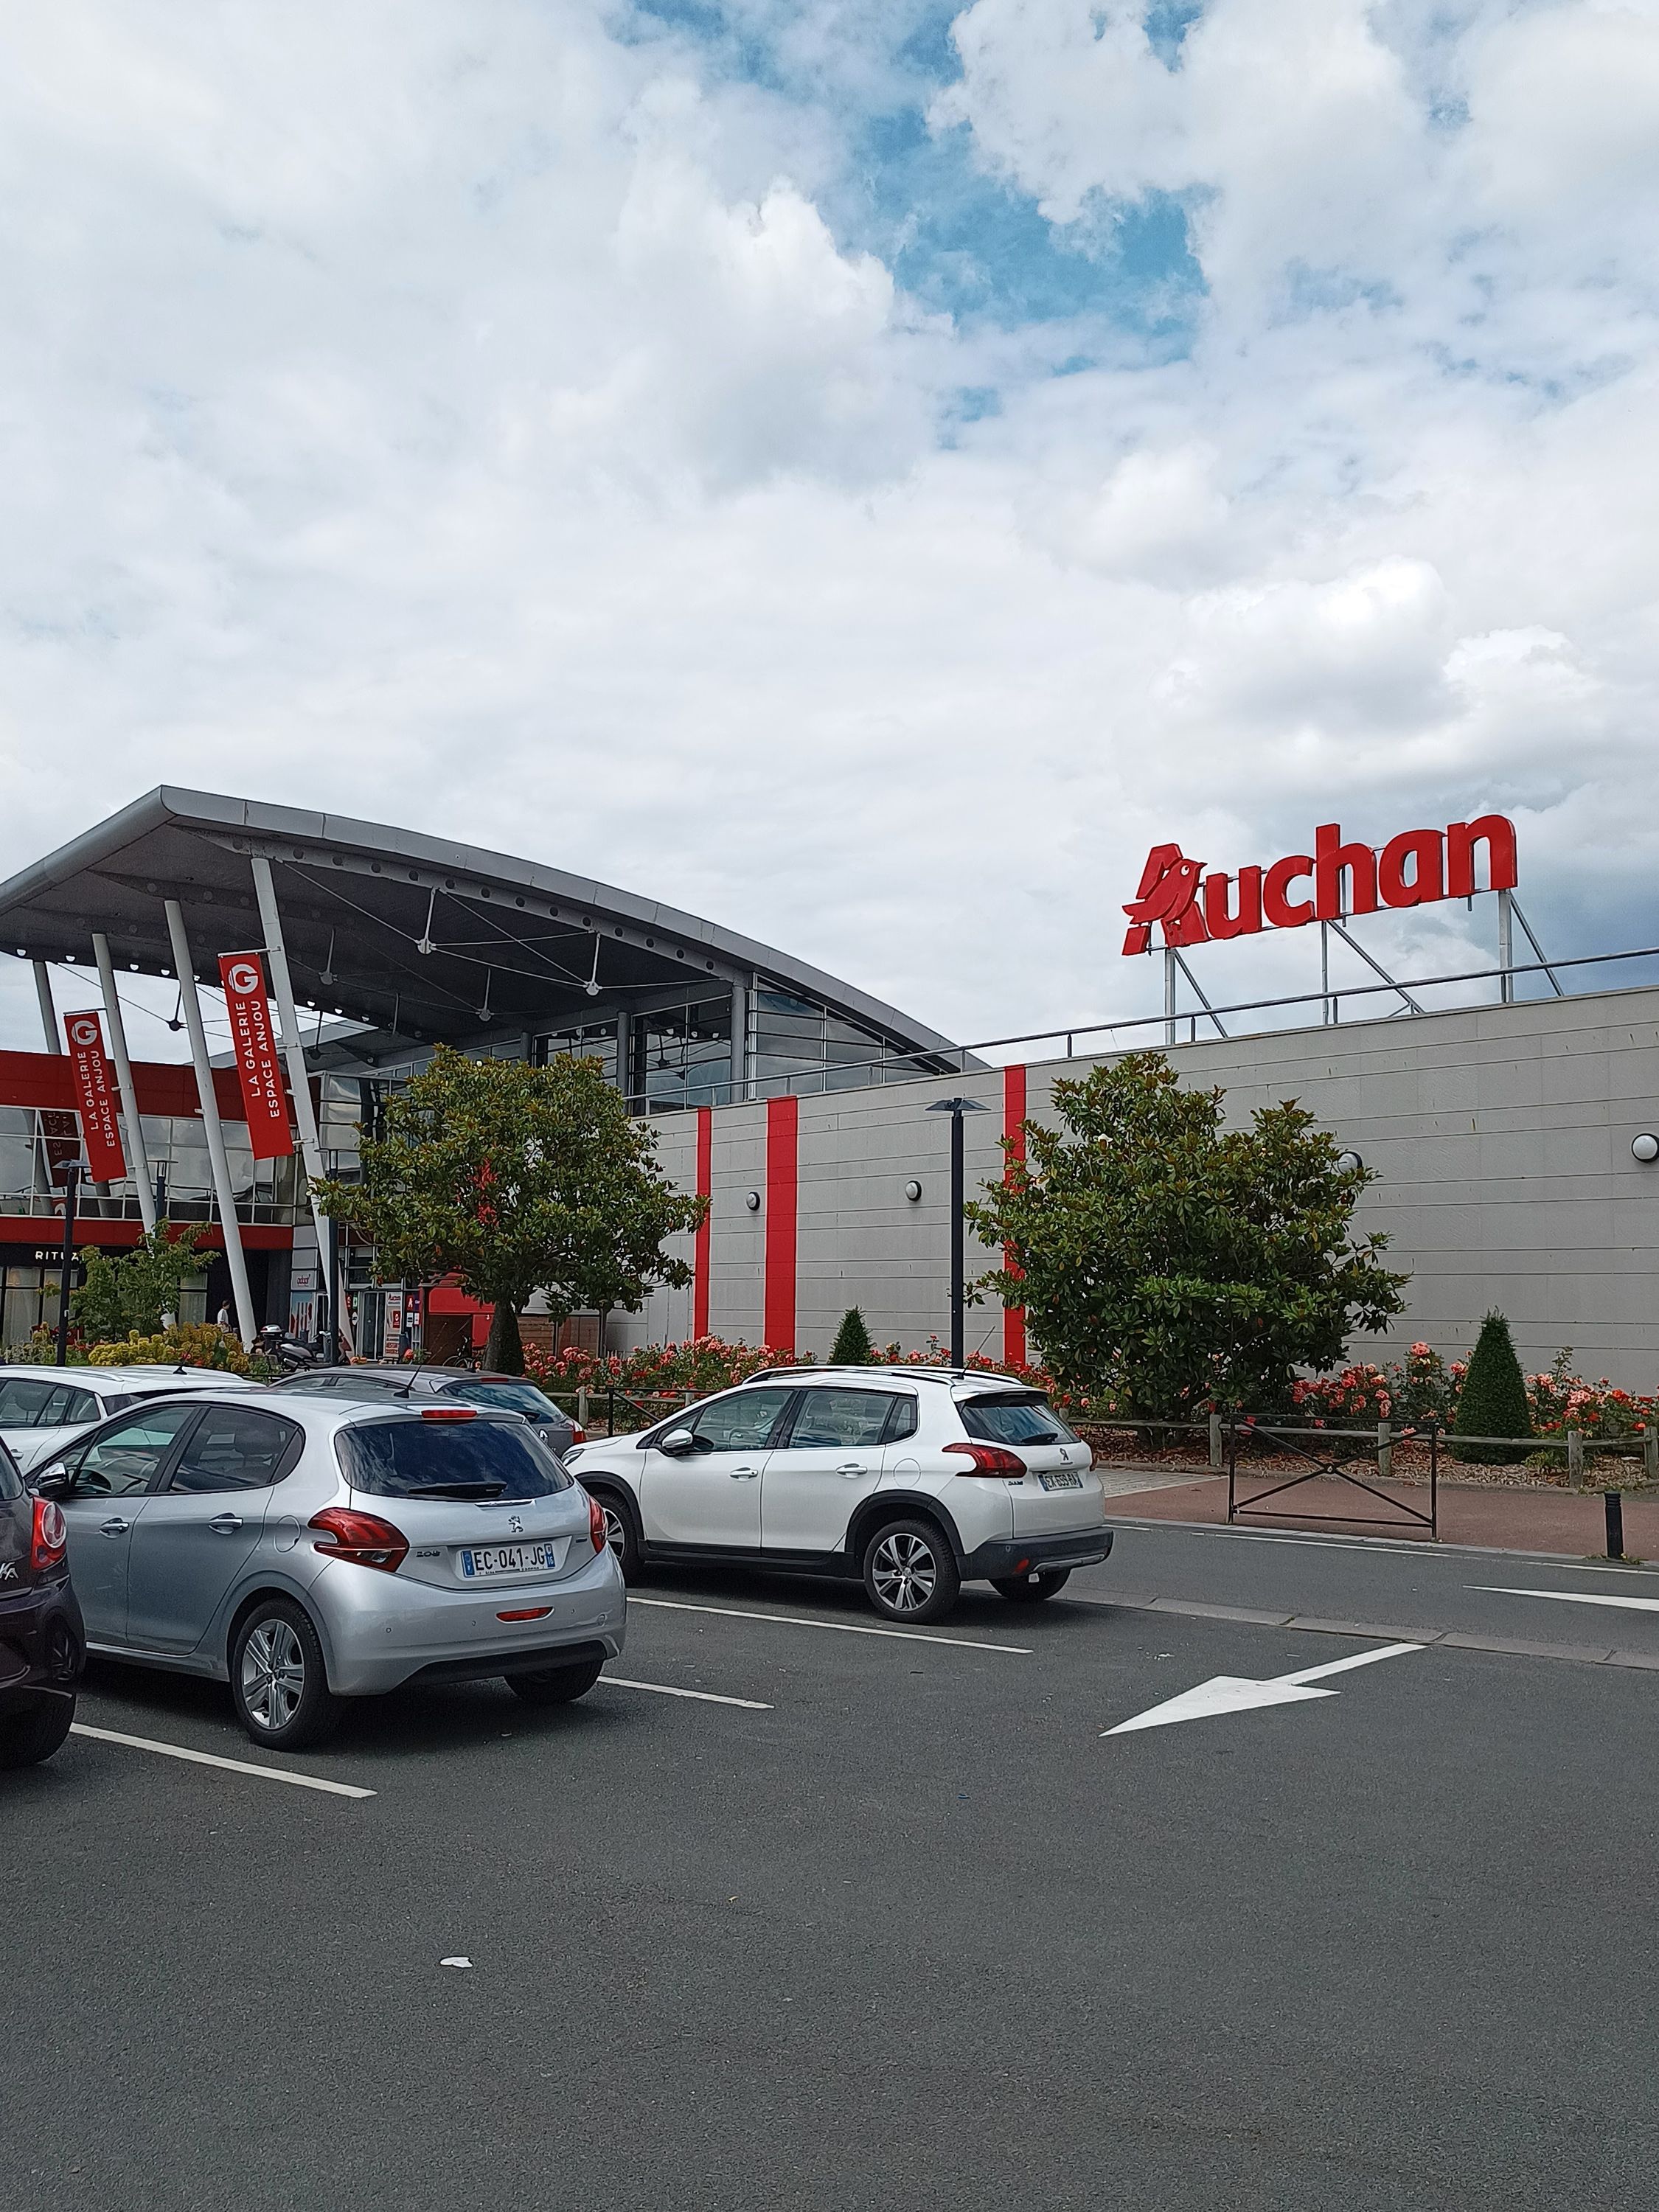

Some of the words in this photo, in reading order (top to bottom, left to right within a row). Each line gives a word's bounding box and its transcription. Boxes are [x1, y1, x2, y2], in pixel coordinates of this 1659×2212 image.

[1122, 815, 1517, 956] Auchan
[235, 1001, 256, 1069] GALERIE
[250, 1001, 269, 1051] ANJOU
[77, 1051, 95, 1107] GALERIE
[90, 1050, 106, 1093] ANJOU
[248, 1075, 261, 1097] LA
[261, 1060, 280, 1118] ESPACE
[88, 1111, 99, 1130] LA
[100, 1099, 116, 1147] ESPACE
